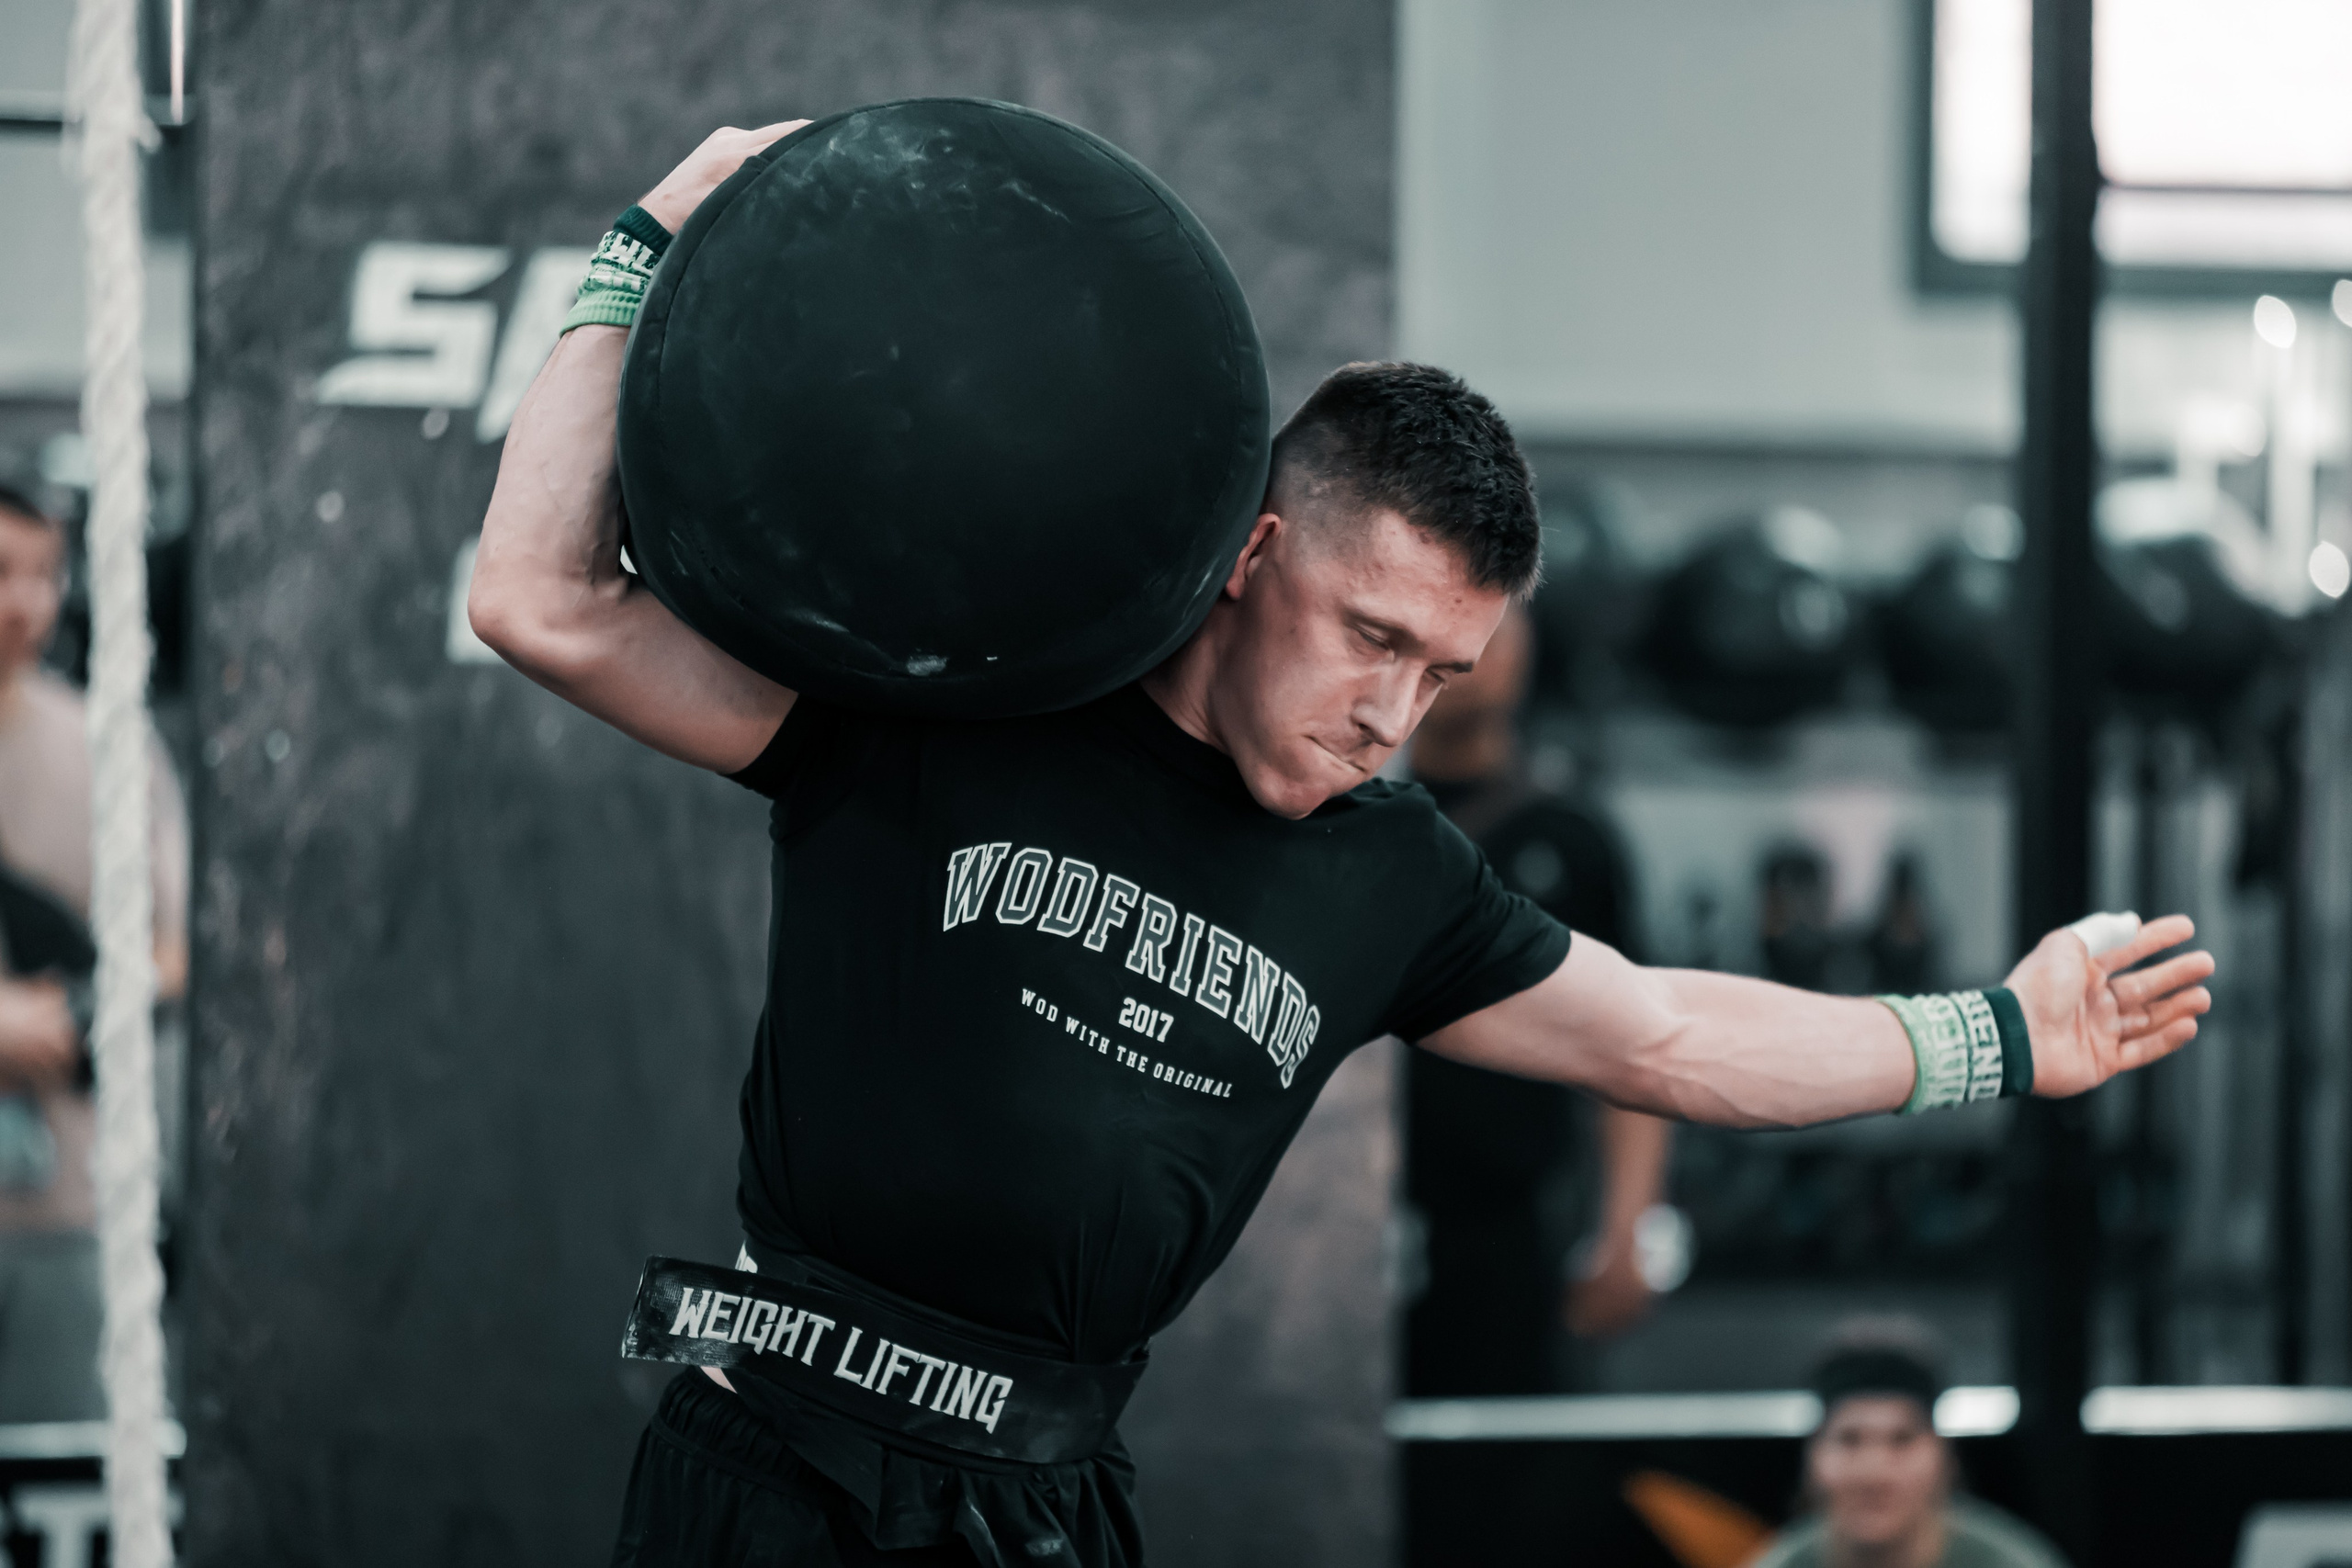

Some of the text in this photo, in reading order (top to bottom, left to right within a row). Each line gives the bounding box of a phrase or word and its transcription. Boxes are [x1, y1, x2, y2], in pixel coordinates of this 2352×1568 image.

[943, 841, 1321, 1089] WODFRIENDS
[1118, 997, 1174, 1043] 2017
[1021, 987, 1233, 1099] WOD WITH THE ORIGINAL
[669, 1286, 1013, 1434] WEIGHT LIFTING
